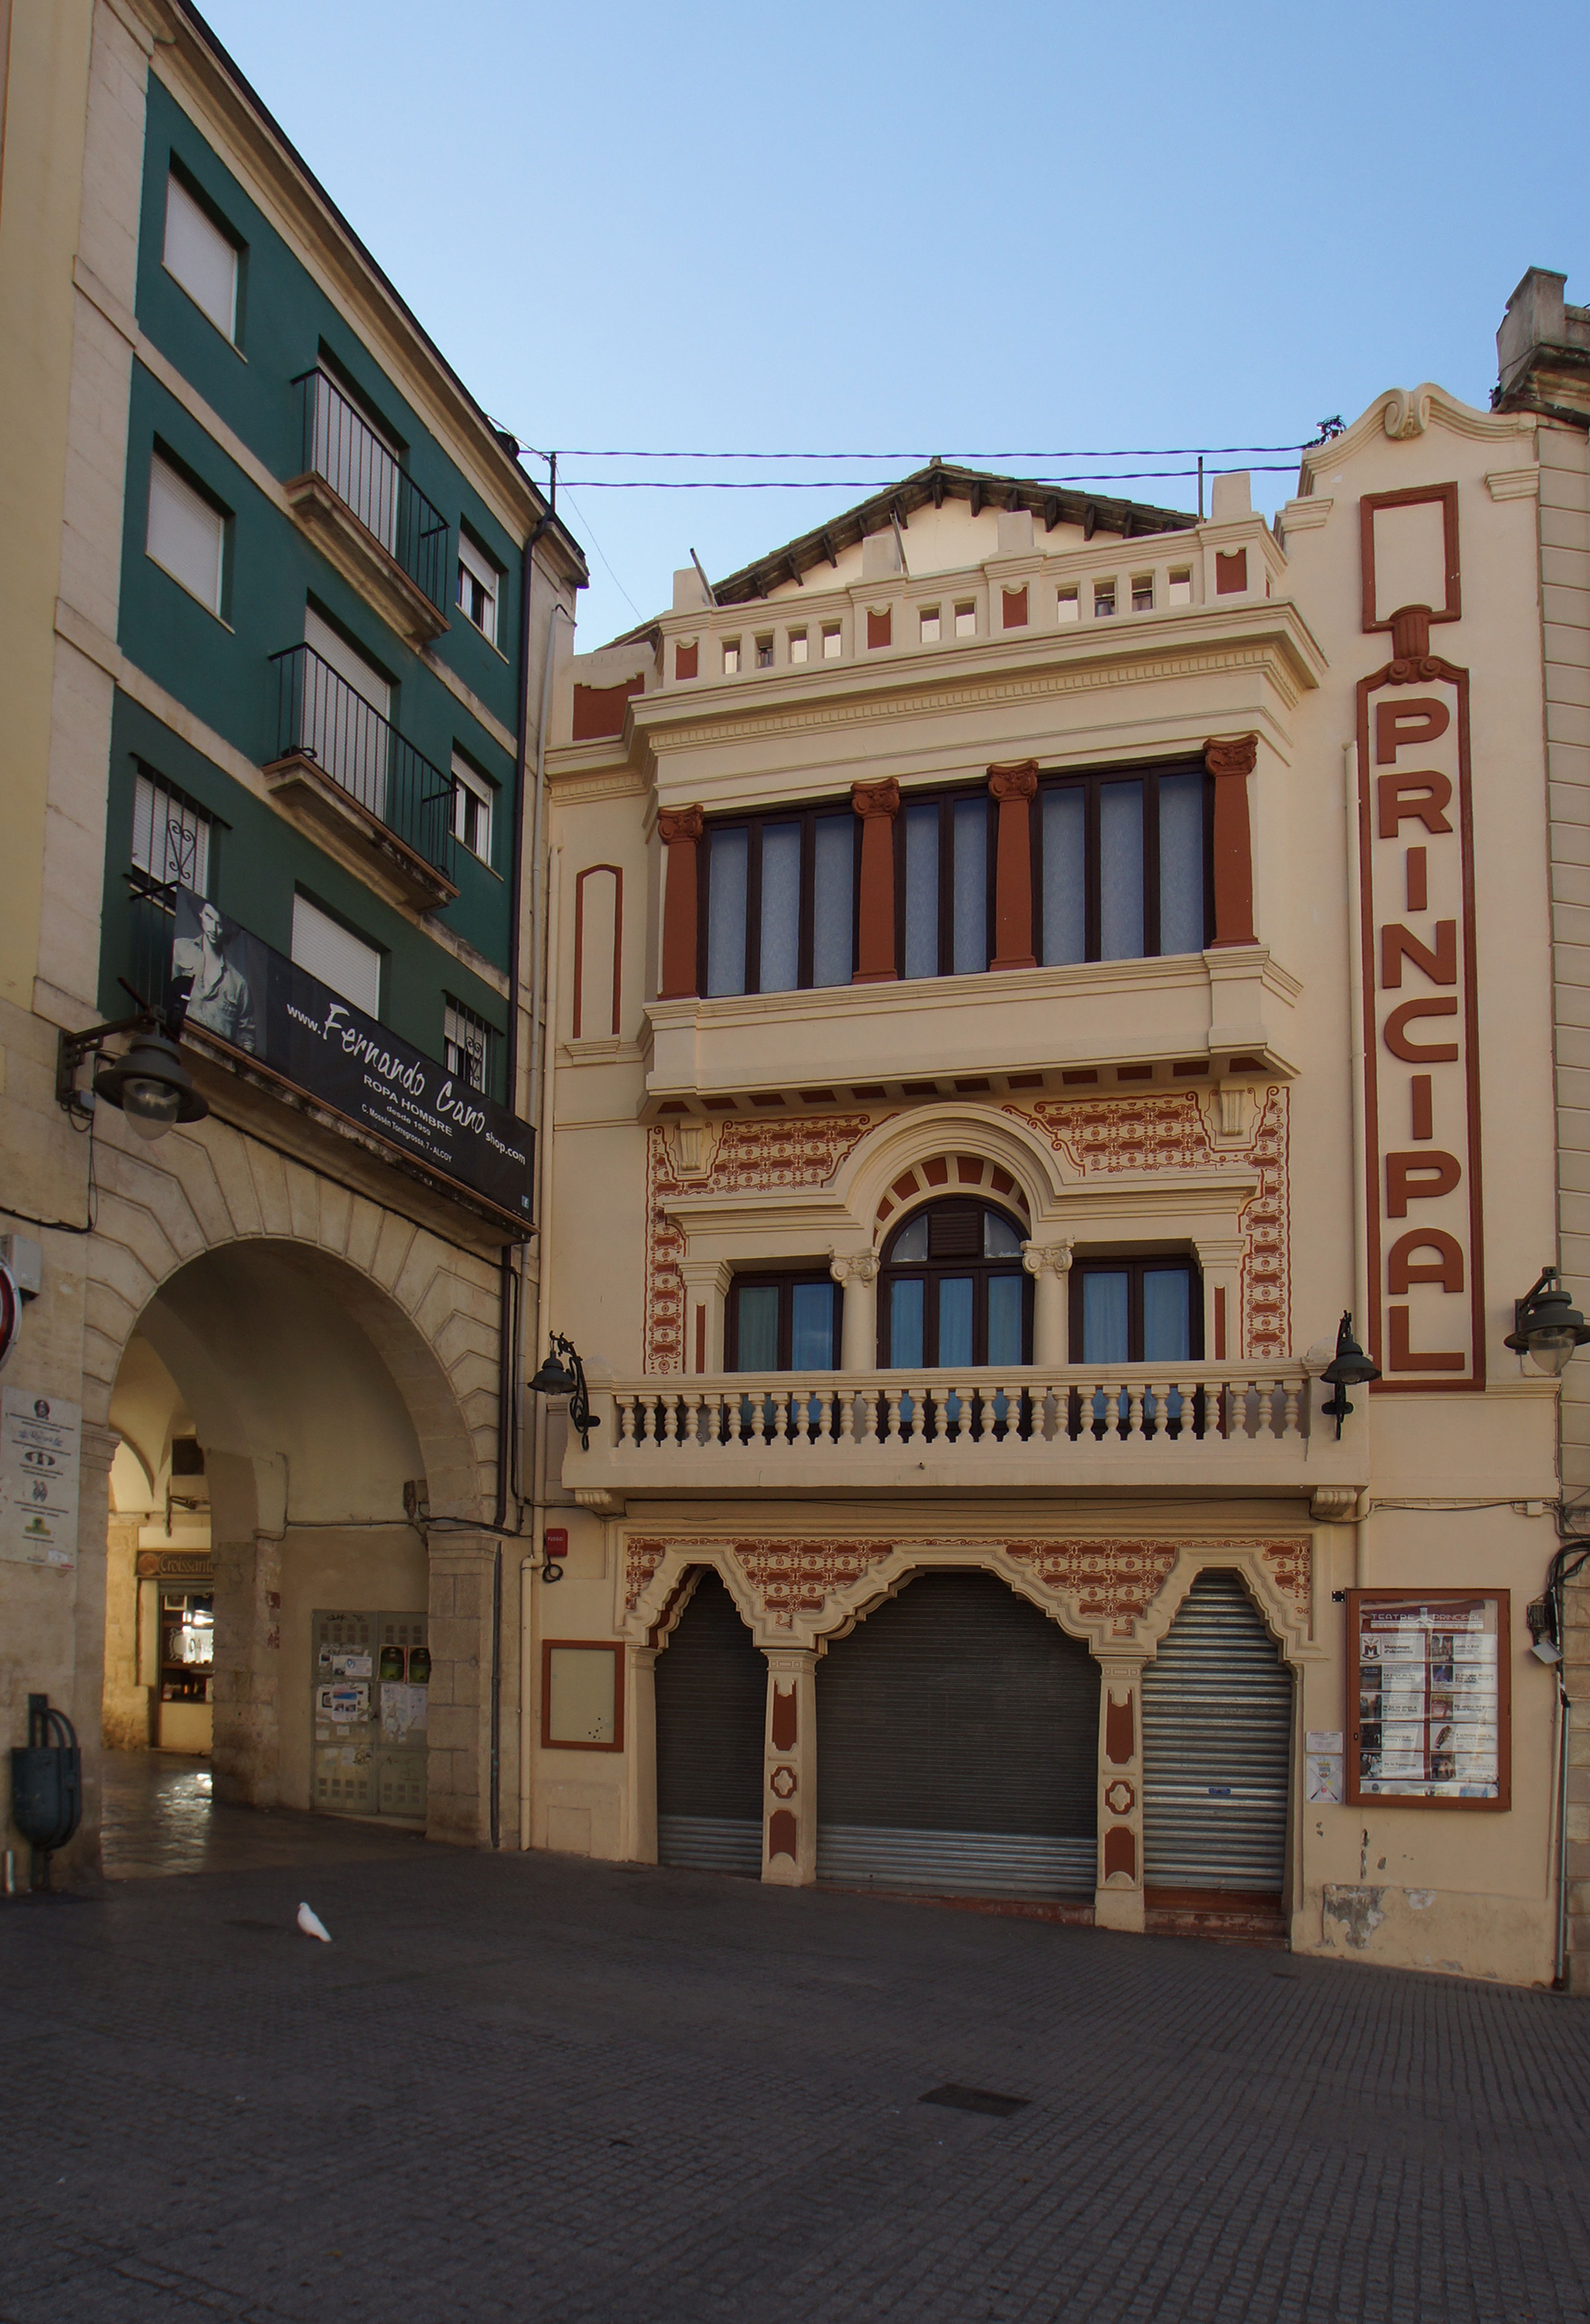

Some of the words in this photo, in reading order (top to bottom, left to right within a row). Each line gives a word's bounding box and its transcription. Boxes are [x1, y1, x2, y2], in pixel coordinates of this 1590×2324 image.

[1376, 697, 1465, 1372] PRINCIPAL
[363, 1074, 398, 1104] ROPA
[401, 1097, 453, 1137] HOMBRE
[386, 1105, 411, 1124] desde
[413, 1120, 431, 1136] 1959
[436, 1080, 486, 1135] Cano
[432, 1146, 453, 1162] ALCOY
